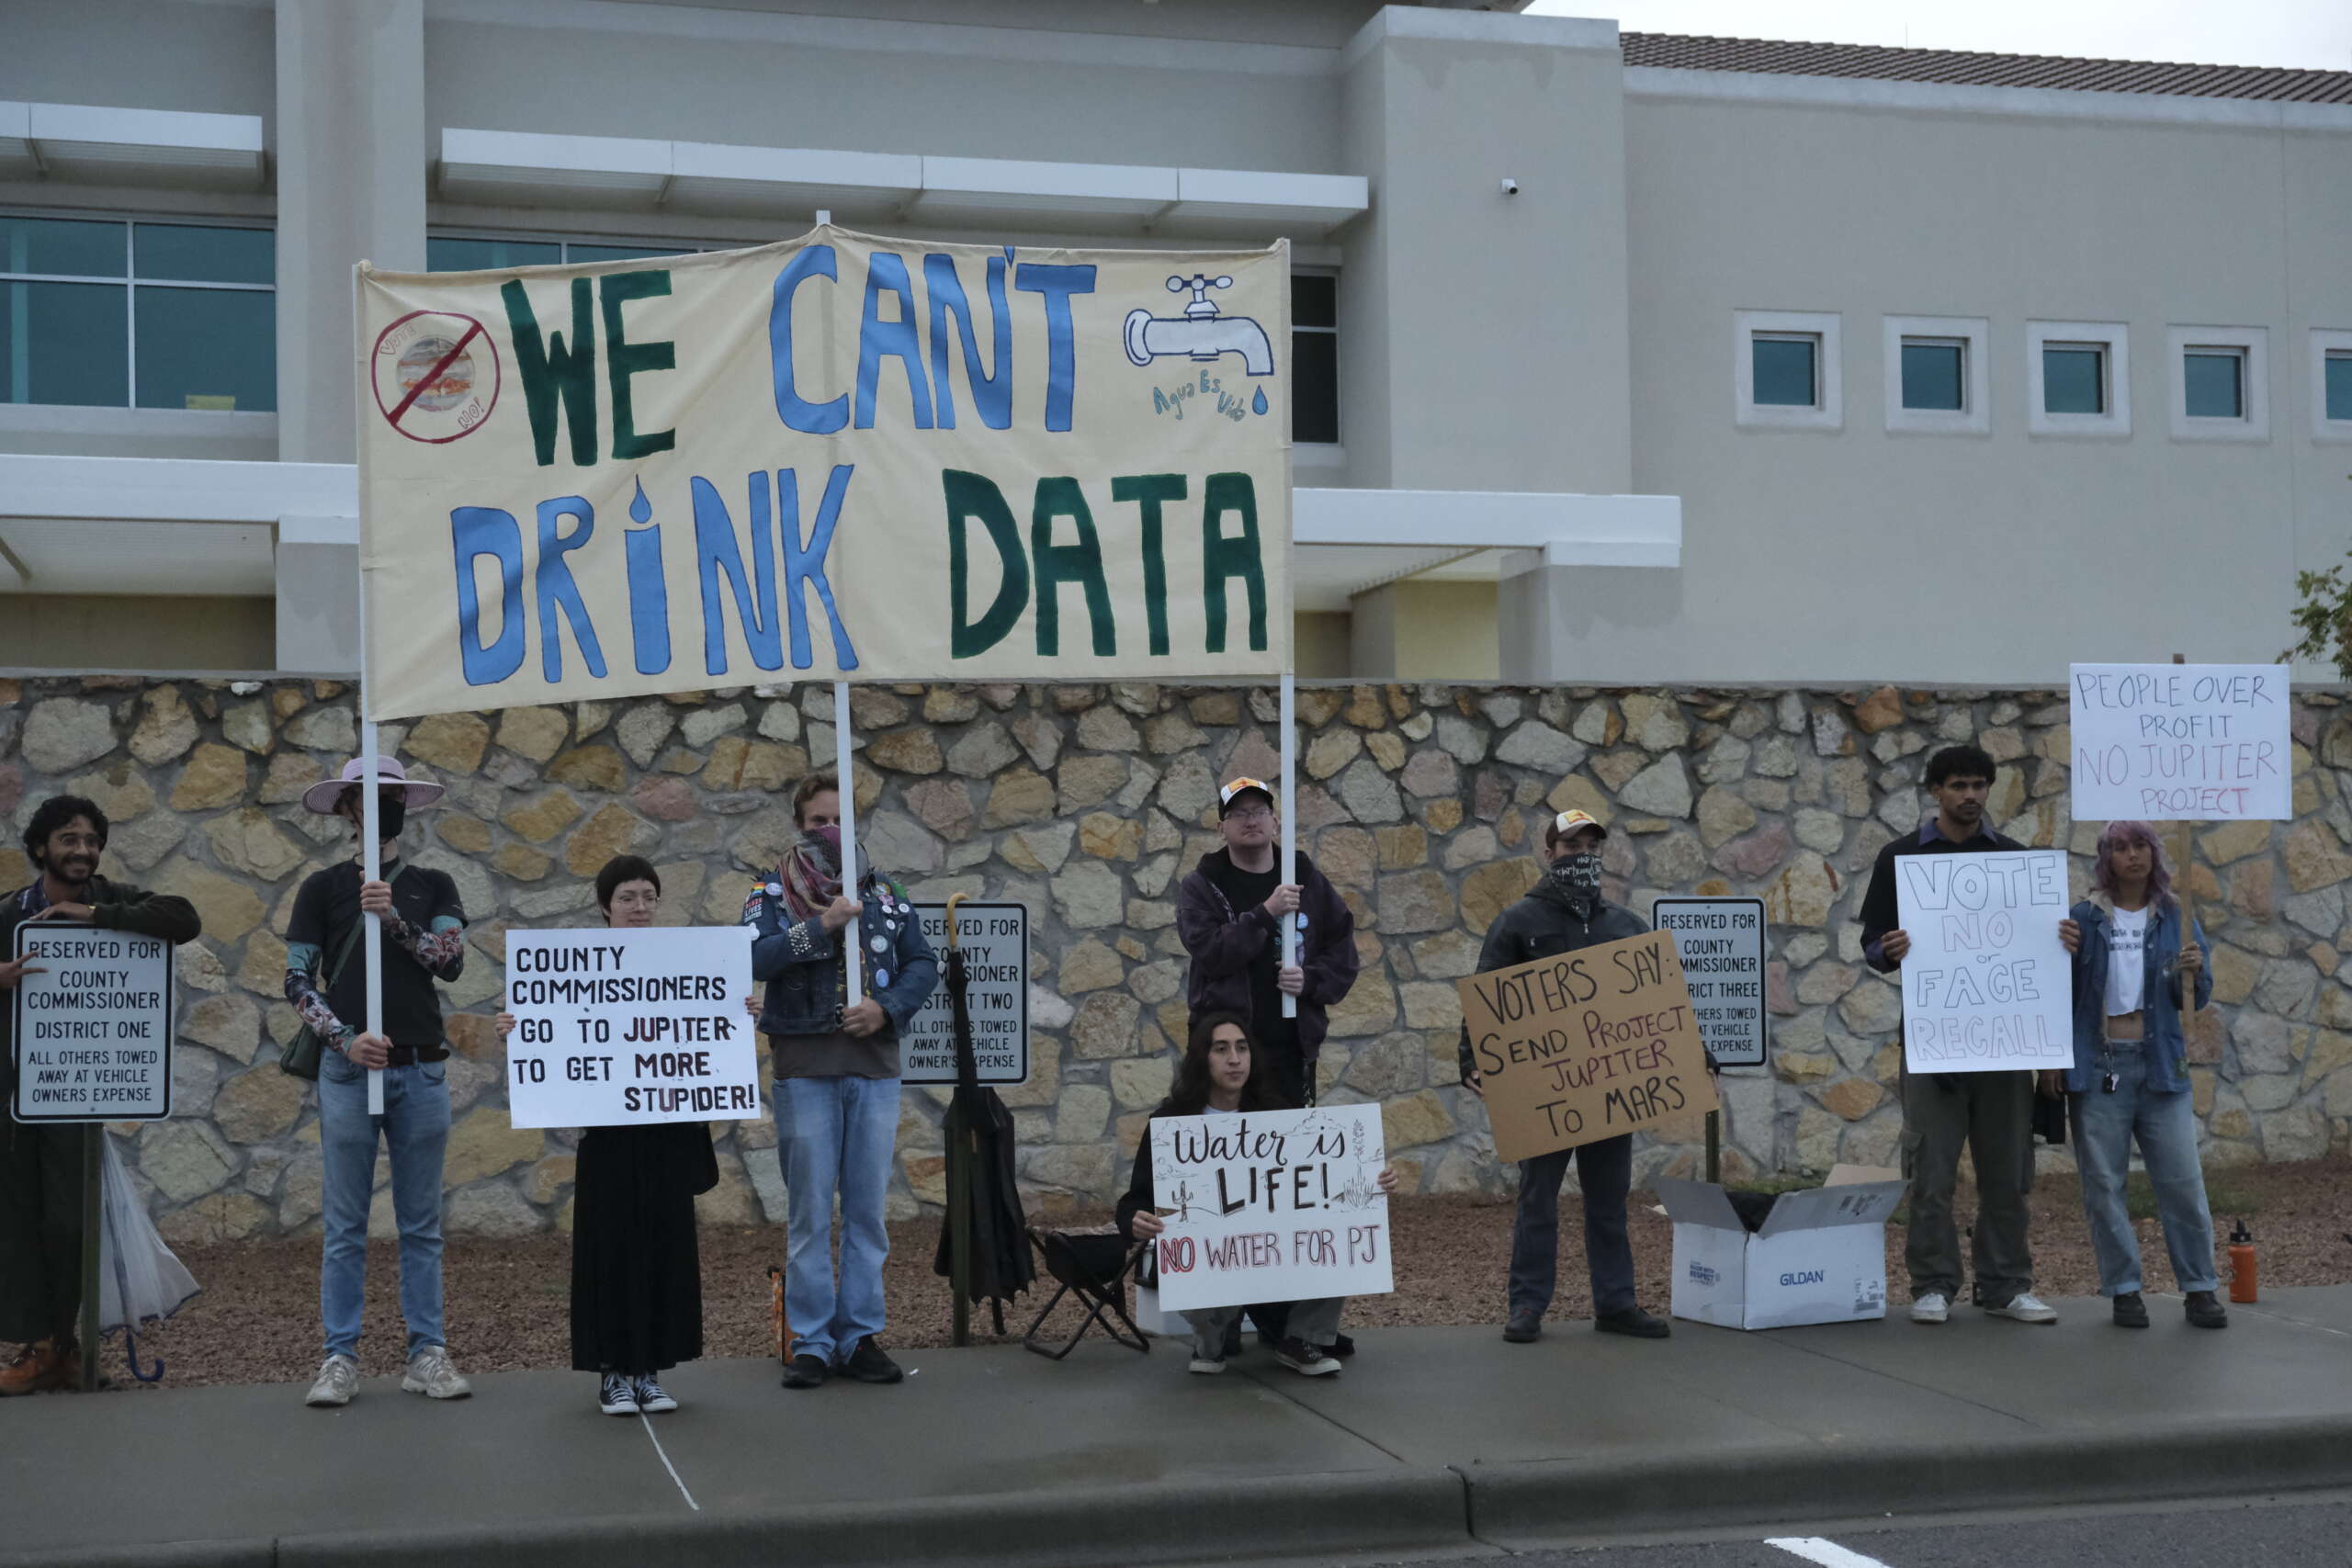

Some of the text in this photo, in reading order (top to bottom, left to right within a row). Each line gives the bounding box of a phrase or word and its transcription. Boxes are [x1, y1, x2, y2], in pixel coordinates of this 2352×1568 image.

[379, 322, 416, 355] VOTE
[501, 244, 1097, 466] WE CAN'T
[1153, 383, 1194, 420] Agua
[1200, 369, 1220, 393] Es
[458, 397, 484, 429] NO!
[943, 468, 1267, 660] DATA
[2076, 673, 2274, 709] PEOPLE OVER
[2140, 714, 2233, 739] PROFIT
[2080, 740, 2278, 786] NO JUPITER
[2141, 786, 2249, 815] PROJECT
[1904, 855, 2060, 911] VOTE
[922, 919, 1019, 935] SEVED FOR
[1661, 914, 1756, 929] RESERVED FOR
[1941, 910, 2013, 953] NO
[28, 942, 161, 958] RESERVED FOR
[516, 945, 625, 972] COUNTY
[932, 947, 991, 963] ONTY
[1684, 940, 1734, 954] COUNTY
[1976, 953, 2001, 964] or
[1679, 957, 1757, 973] MMISSIONER
[60, 971, 129, 988] COUNTY
[513, 976, 727, 1005] COMMISSIONERS
[1474, 942, 1673, 1025] VOTERS SAY:
[1688, 982, 1758, 998] RICT THREE
[1917, 959, 2040, 1009] FACE
[28, 992, 160, 1010] COMMISSIONER
[981, 993, 1013, 1010] TWO
[1693, 1008, 1757, 1020] HERS TOWED
[36, 1021, 151, 1039] DISTRICT ONE
[521, 1016, 731, 1043] GO TO JUPITER
[912, 1021, 1016, 1033] LL OTHS TOWED
[1711, 1024, 1749, 1035] VEHICLE
[1910, 1014, 2065, 1061] RECALL
[912, 1038, 940, 1051] AWAY
[970, 1038, 1009, 1051] EHICLE
[1479, 1006, 1686, 1076] SEND PROJECT
[1712, 1040, 1754, 1052] EXPENSE
[28, 1050, 157, 1065] ALL OTHERS TOWED
[513, 1052, 711, 1084] TO GET MORE
[909, 1055, 1014, 1068] OWNER'S PENSE
[37, 1069, 148, 1083] AWAY AT VEHICLE
[32, 1088, 152, 1102] OWNERS EXPENSE
[625, 1084, 755, 1112] STUPIDER!
[1606, 1076, 1685, 1124] MARS
[1175, 1119, 1346, 1166] Water is
[1216, 1162, 1329, 1217] LIFE!
[1160, 1224, 1382, 1274] NO WATER FOR PJ
[1780, 1270, 1824, 1286] GILDAN
